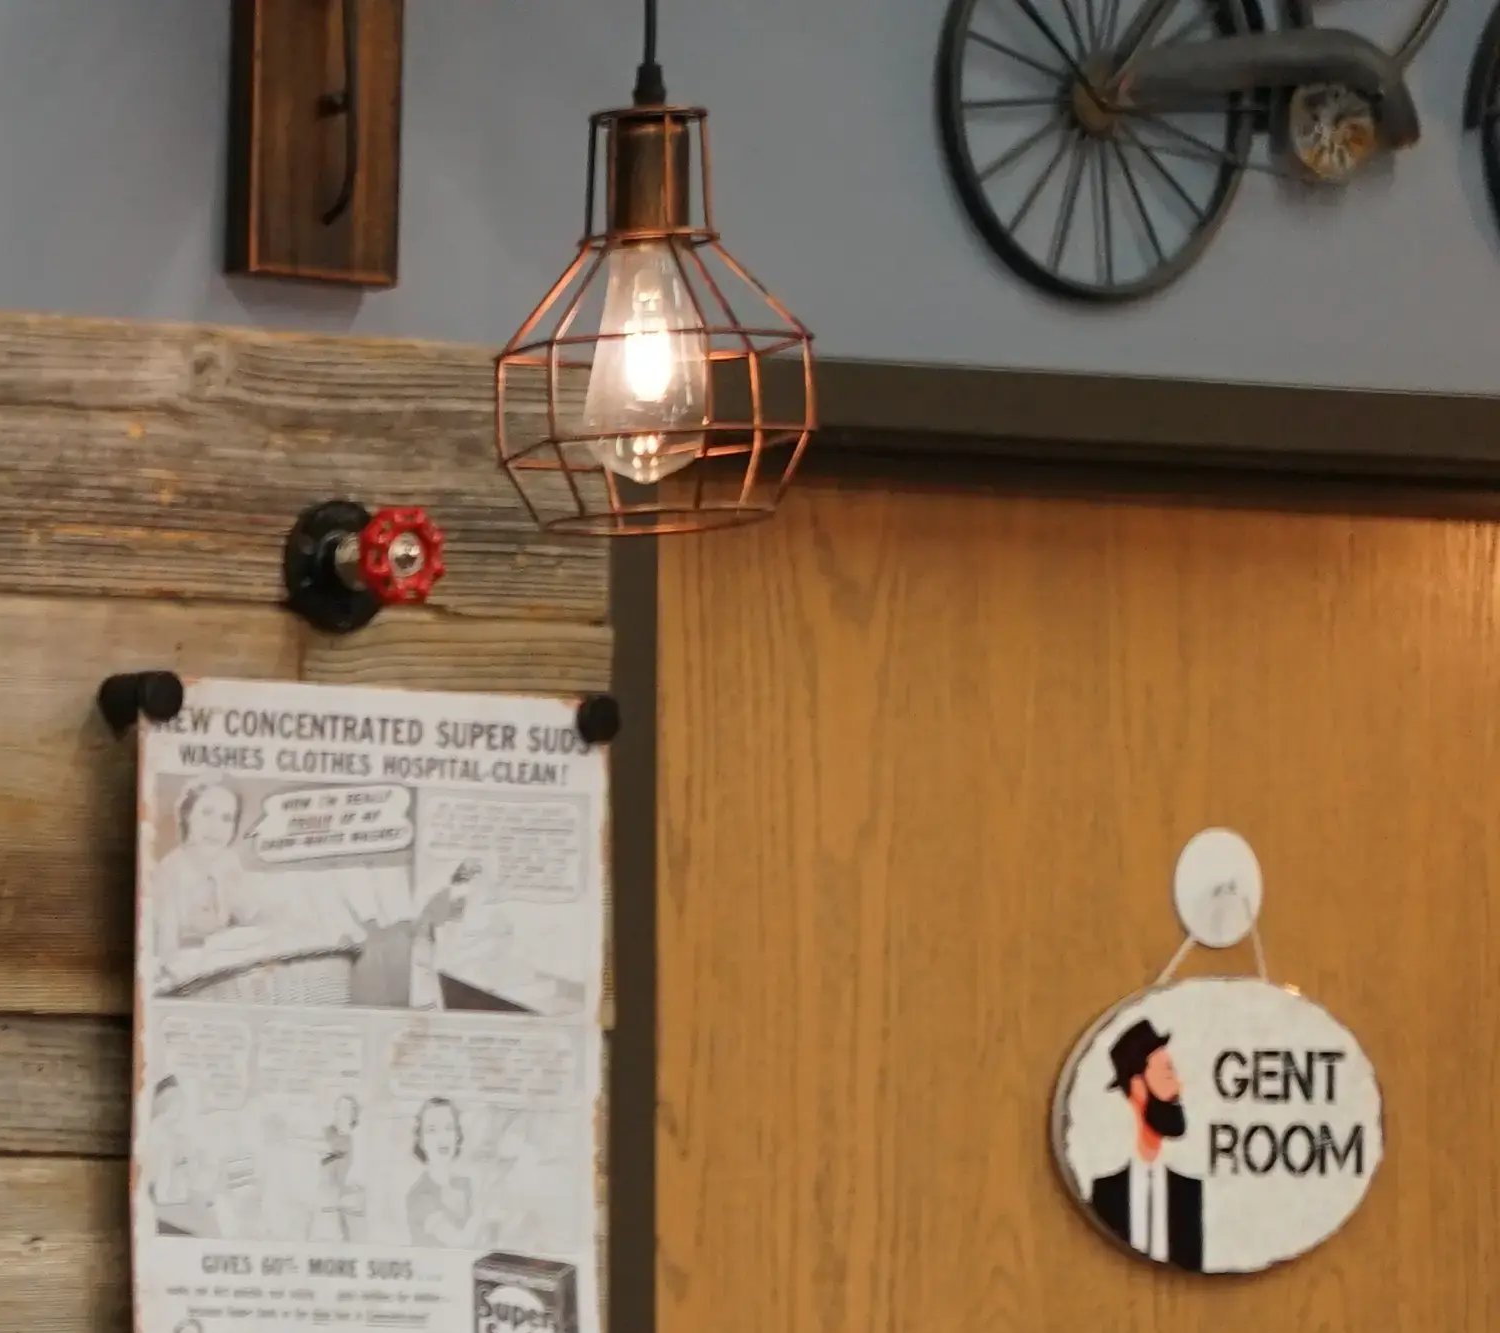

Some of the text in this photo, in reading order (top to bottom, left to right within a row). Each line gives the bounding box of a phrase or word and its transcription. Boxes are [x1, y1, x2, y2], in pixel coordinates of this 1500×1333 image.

[224, 709, 422, 746] CONCENTRATED
[436, 720, 517, 751] SUPER
[180, 745, 264, 770] WASHES
[276, 749, 372, 777] CLOTHES
[1213, 1050, 1346, 1102] GENT
[1209, 1123, 1365, 1177] ROOM
